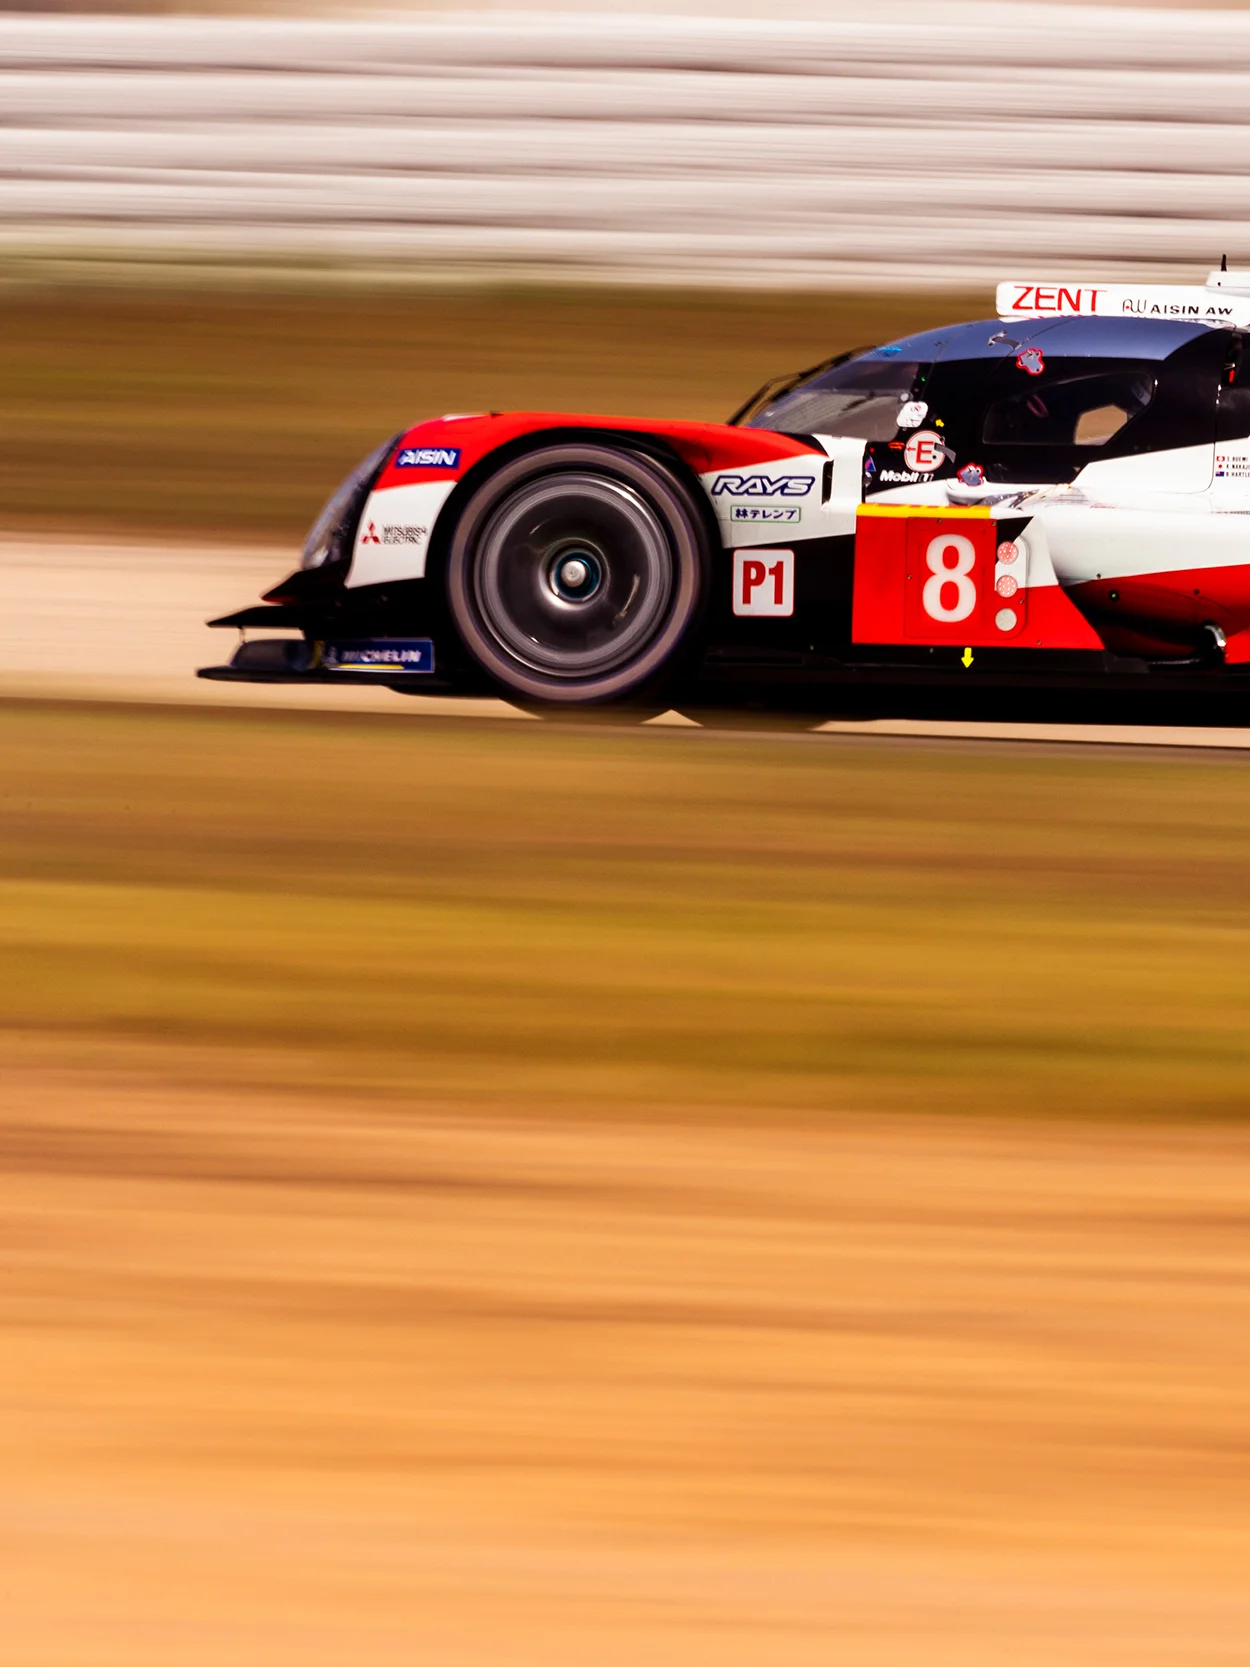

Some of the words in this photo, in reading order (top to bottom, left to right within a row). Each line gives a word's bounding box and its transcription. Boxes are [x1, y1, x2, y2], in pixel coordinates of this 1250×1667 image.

[1012, 285, 1107, 312] ZENT
[1150, 304, 1200, 315] AISIN
[1206, 307, 1233, 316] AW
[398, 449, 457, 466] AISIN
[916, 441, 935, 464] E
[711, 475, 815, 496] RAYS
[880, 469, 919, 483] Mobil
[735, 508, 797, 520] 林テレンプ
[742, 560, 784, 605] P1
[922, 533, 977, 623] 8
